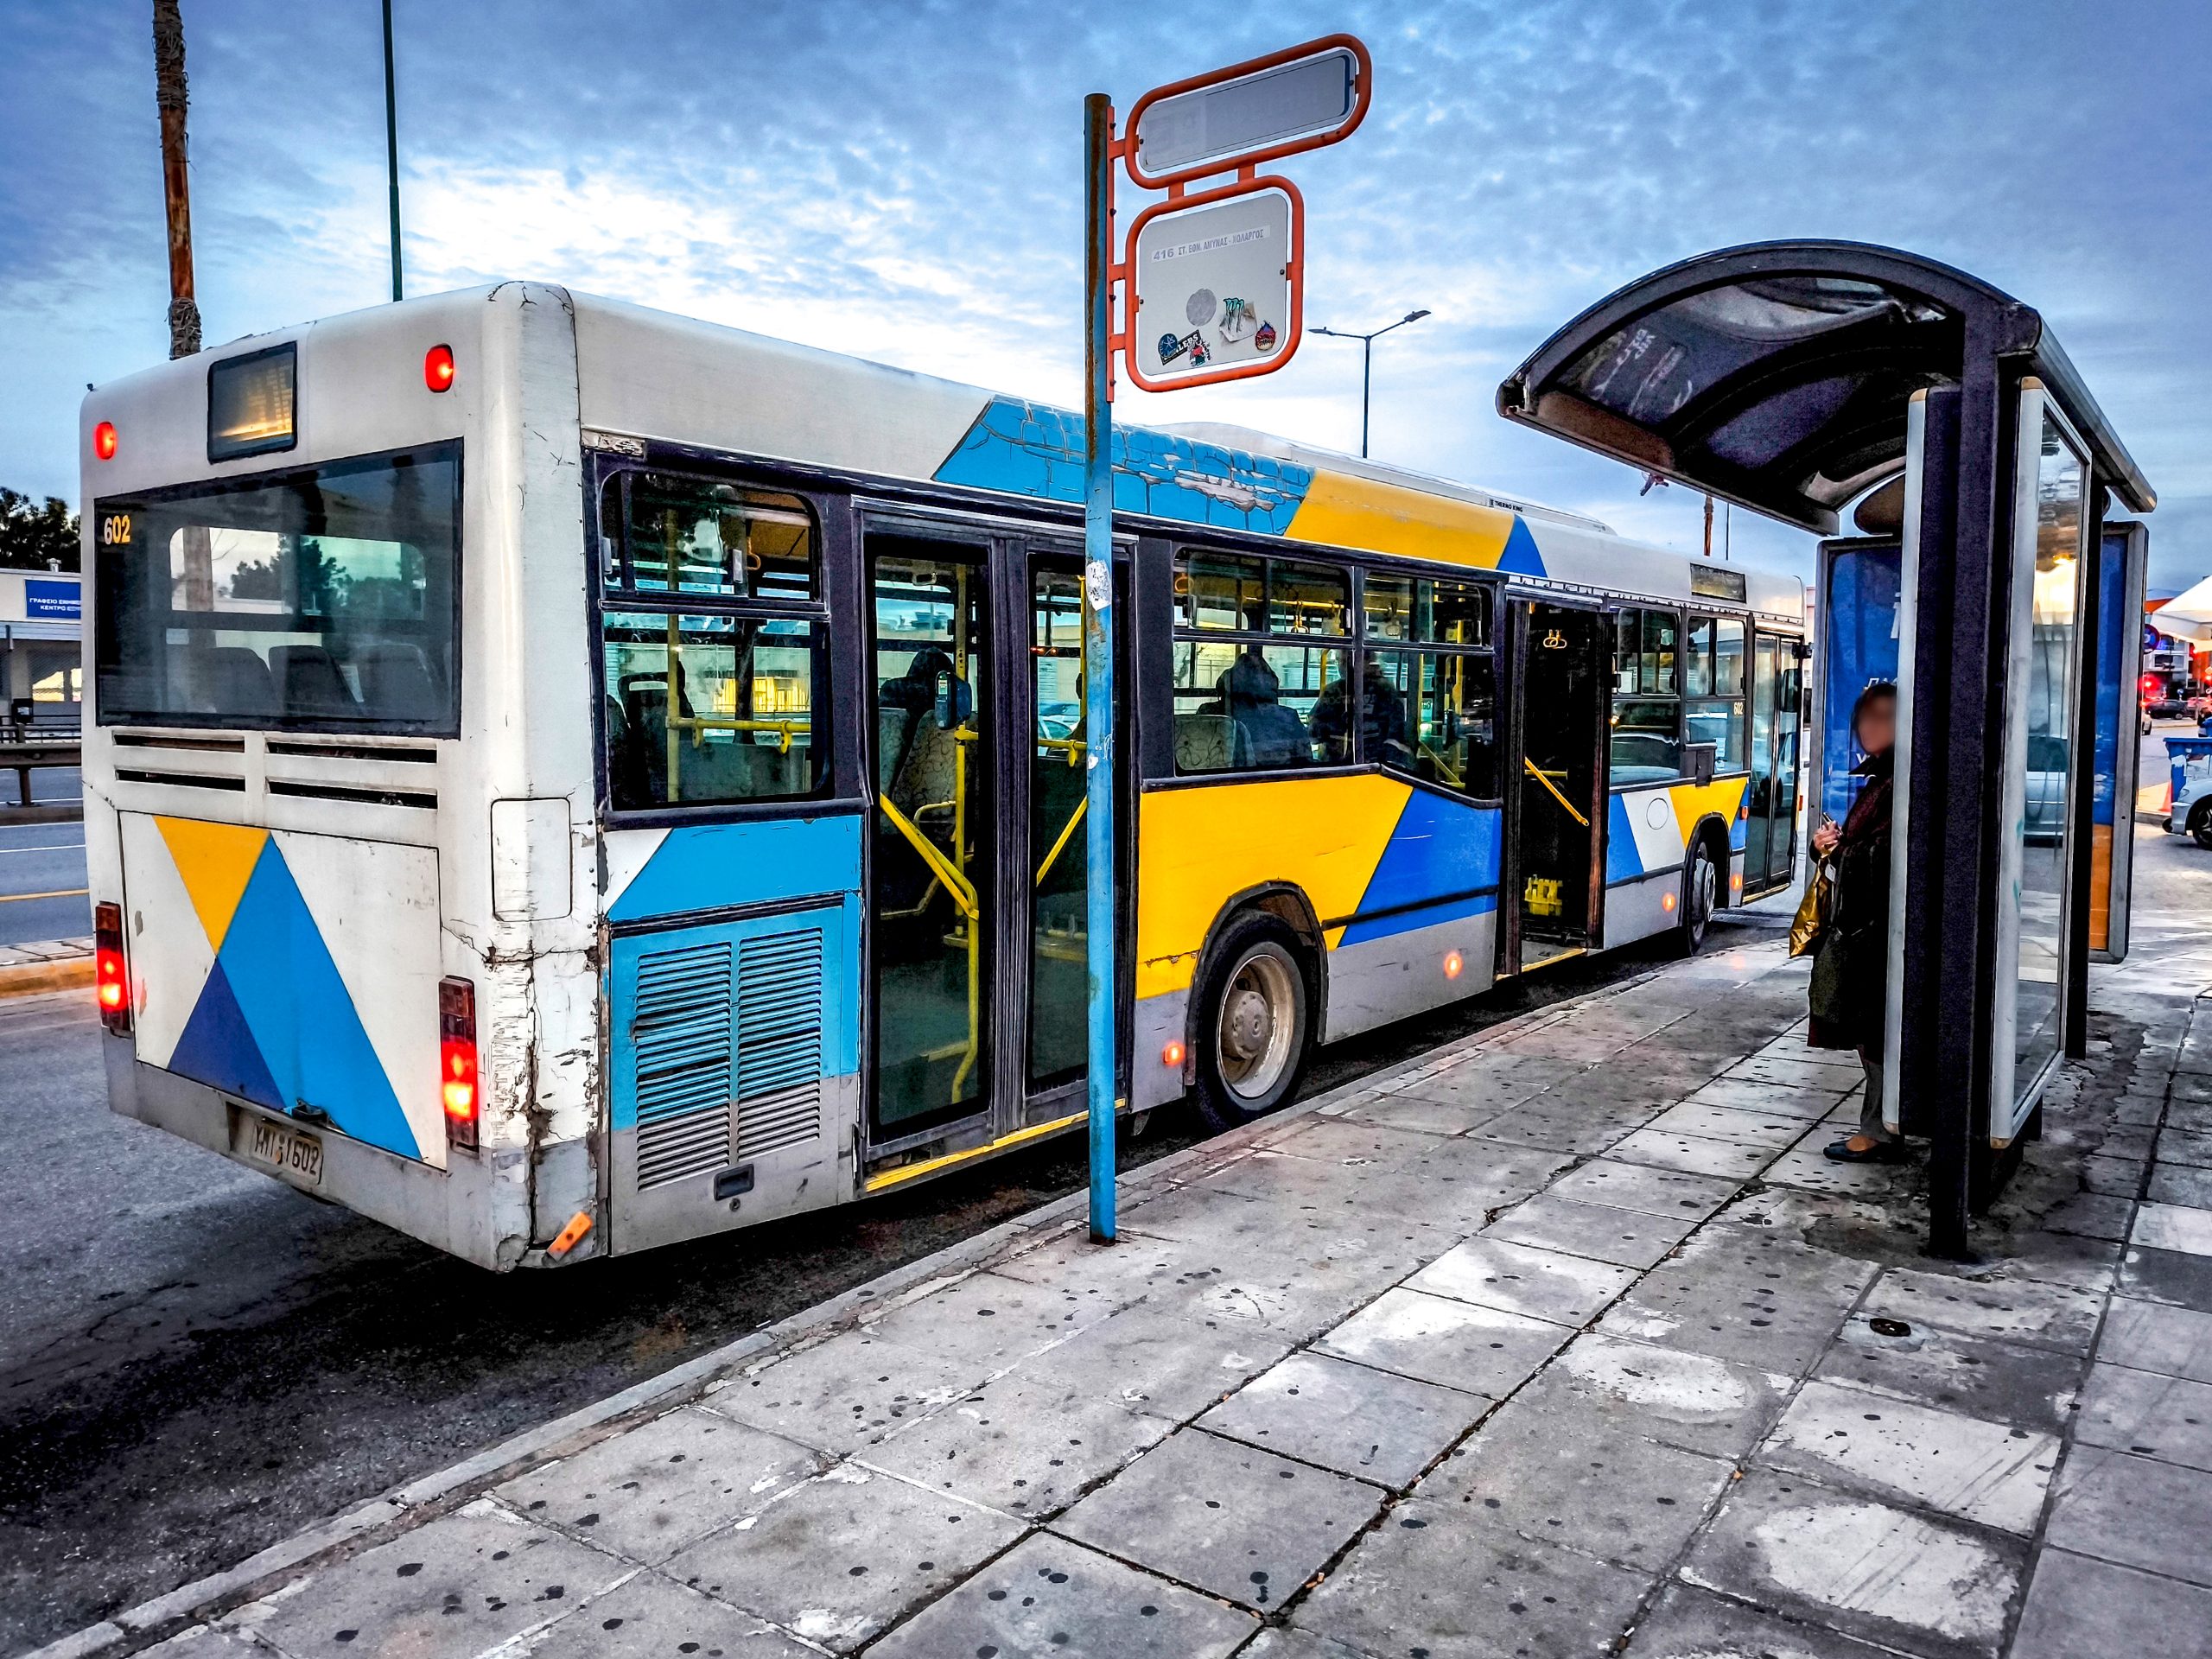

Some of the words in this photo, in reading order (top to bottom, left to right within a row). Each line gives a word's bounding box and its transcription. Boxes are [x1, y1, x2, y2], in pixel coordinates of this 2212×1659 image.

[1153, 248, 1174, 260] 416
[104, 514, 130, 545] 602
[1733, 701, 1744, 715] 602
